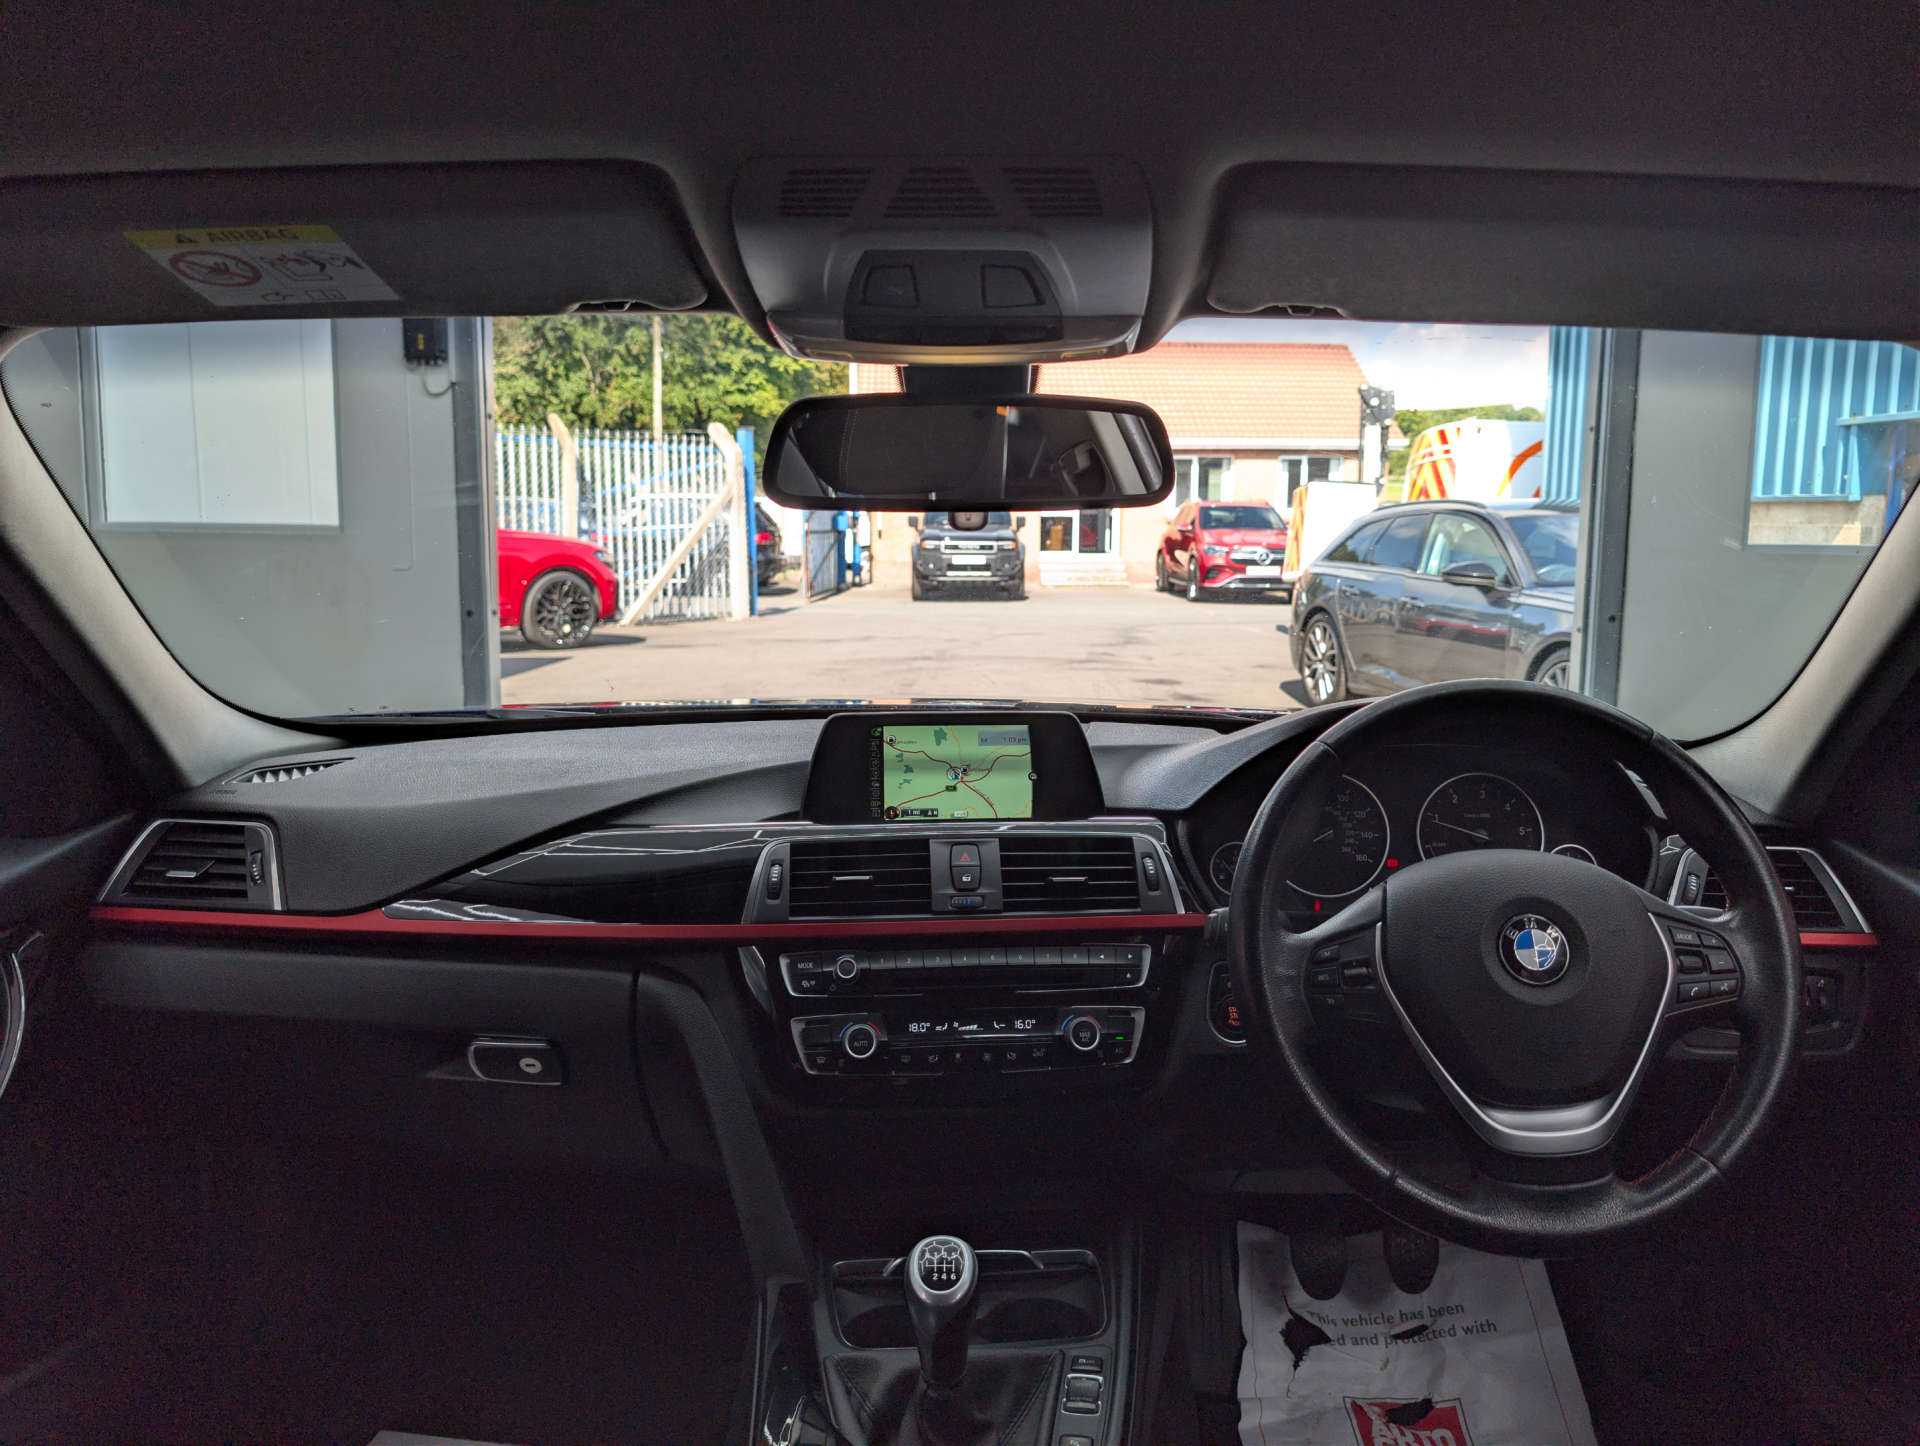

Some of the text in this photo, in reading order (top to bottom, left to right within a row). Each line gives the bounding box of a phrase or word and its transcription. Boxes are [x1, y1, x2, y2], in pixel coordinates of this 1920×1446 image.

[206, 229, 300, 243] AIRBAG
[1360, 831, 1374, 840] 140
[1355, 854, 1368, 862] 160
[797, 961, 815, 969] MODE
[852, 1040, 869, 1048] AUTO
[932, 1272, 957, 1281] 2 4 6
[1341, 1312, 1395, 1327] vehicle
[1399, 1310, 1425, 1322] has
[1427, 1305, 1465, 1318] been
[1351, 1333, 1379, 1346] and
[1461, 1319, 1498, 1336] with
